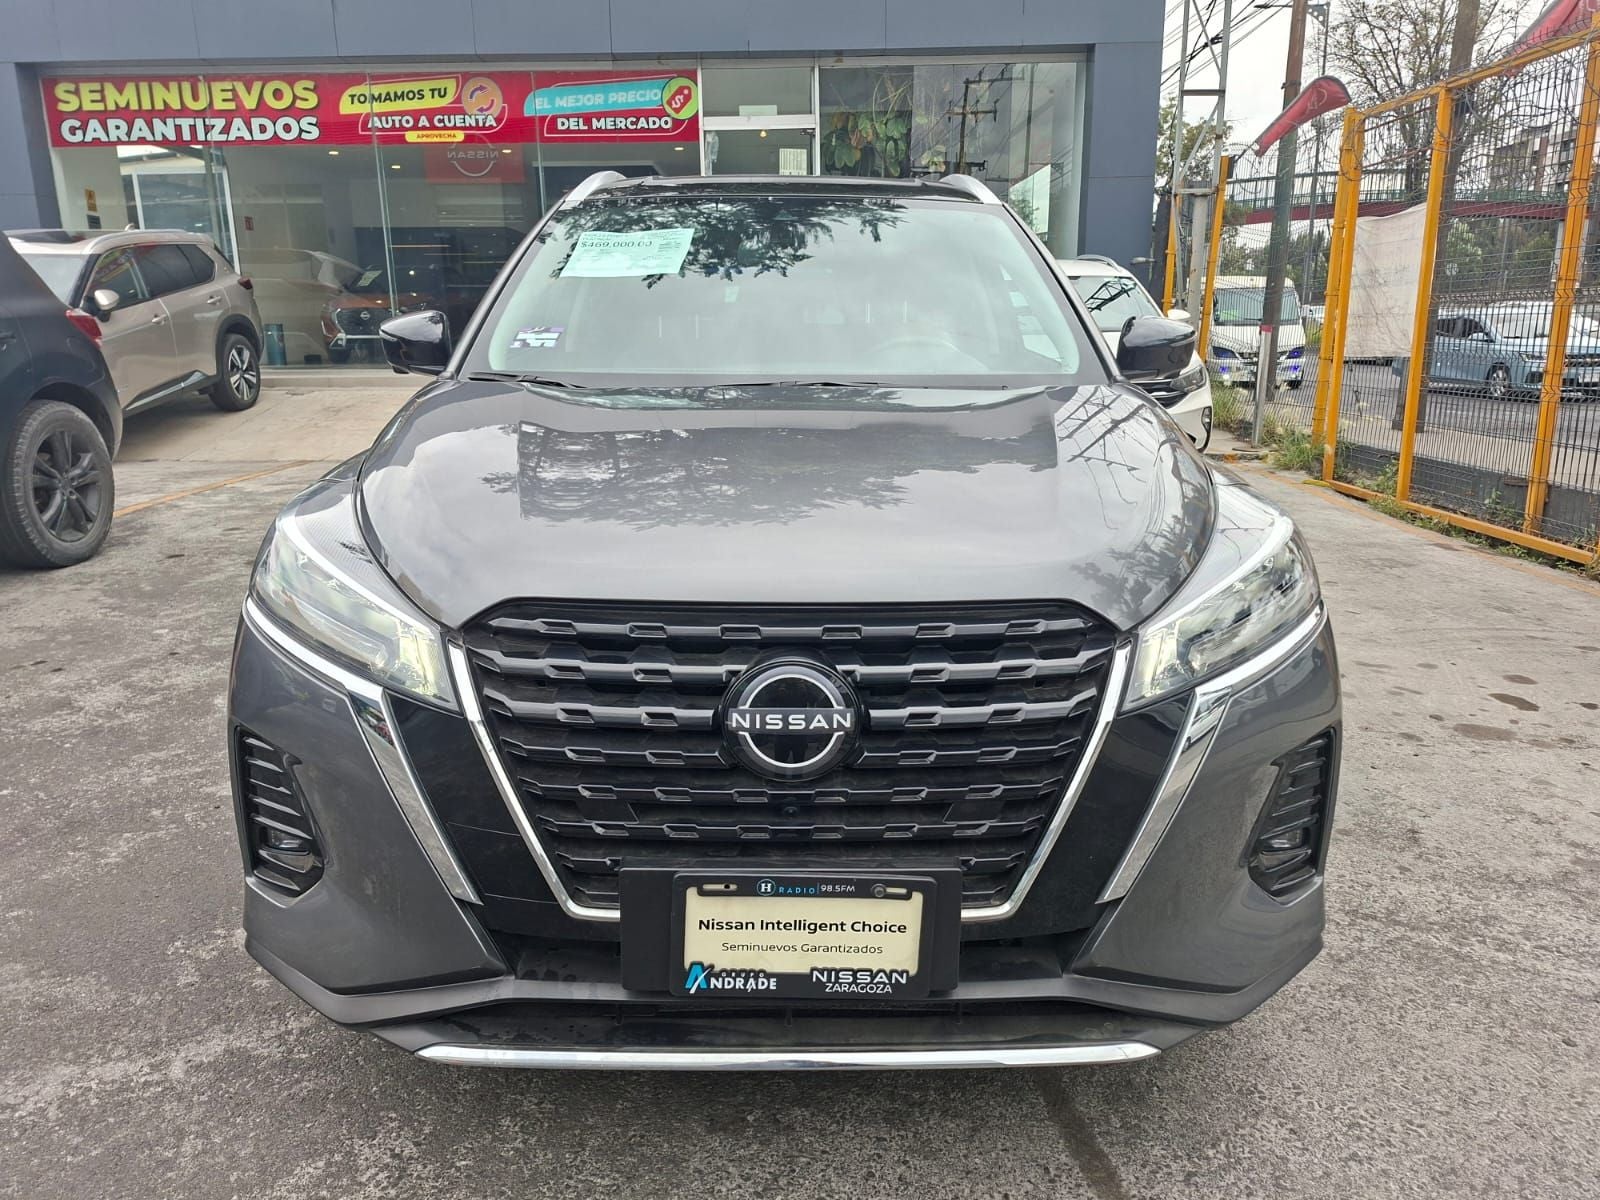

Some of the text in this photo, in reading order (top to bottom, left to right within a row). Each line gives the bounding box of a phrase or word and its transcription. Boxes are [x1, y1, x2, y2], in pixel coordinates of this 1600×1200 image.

[54, 80, 320, 112] SEMINUEVOS
[348, 87, 448, 105] TOMAMOS TU
[535, 89, 662, 109] EL MEJOR PRECIO
[368, 114, 497, 129] AUTO A CUENTA
[557, 117, 673, 130] DEL MERCADO
[59, 116, 321, 143] GARANTIZADOS
[732, 713, 851, 730] NISSAN
[779, 886, 815, 894] RADIO
[821, 884, 856, 893] 98.5FM
[698, 919, 908, 934] Nissan Intelligent Choice
[721, 942, 884, 954] Seminuevos Garantizados
[812, 970, 908, 984] NISSAN
[825, 983, 892, 994] ZARAGOZA
